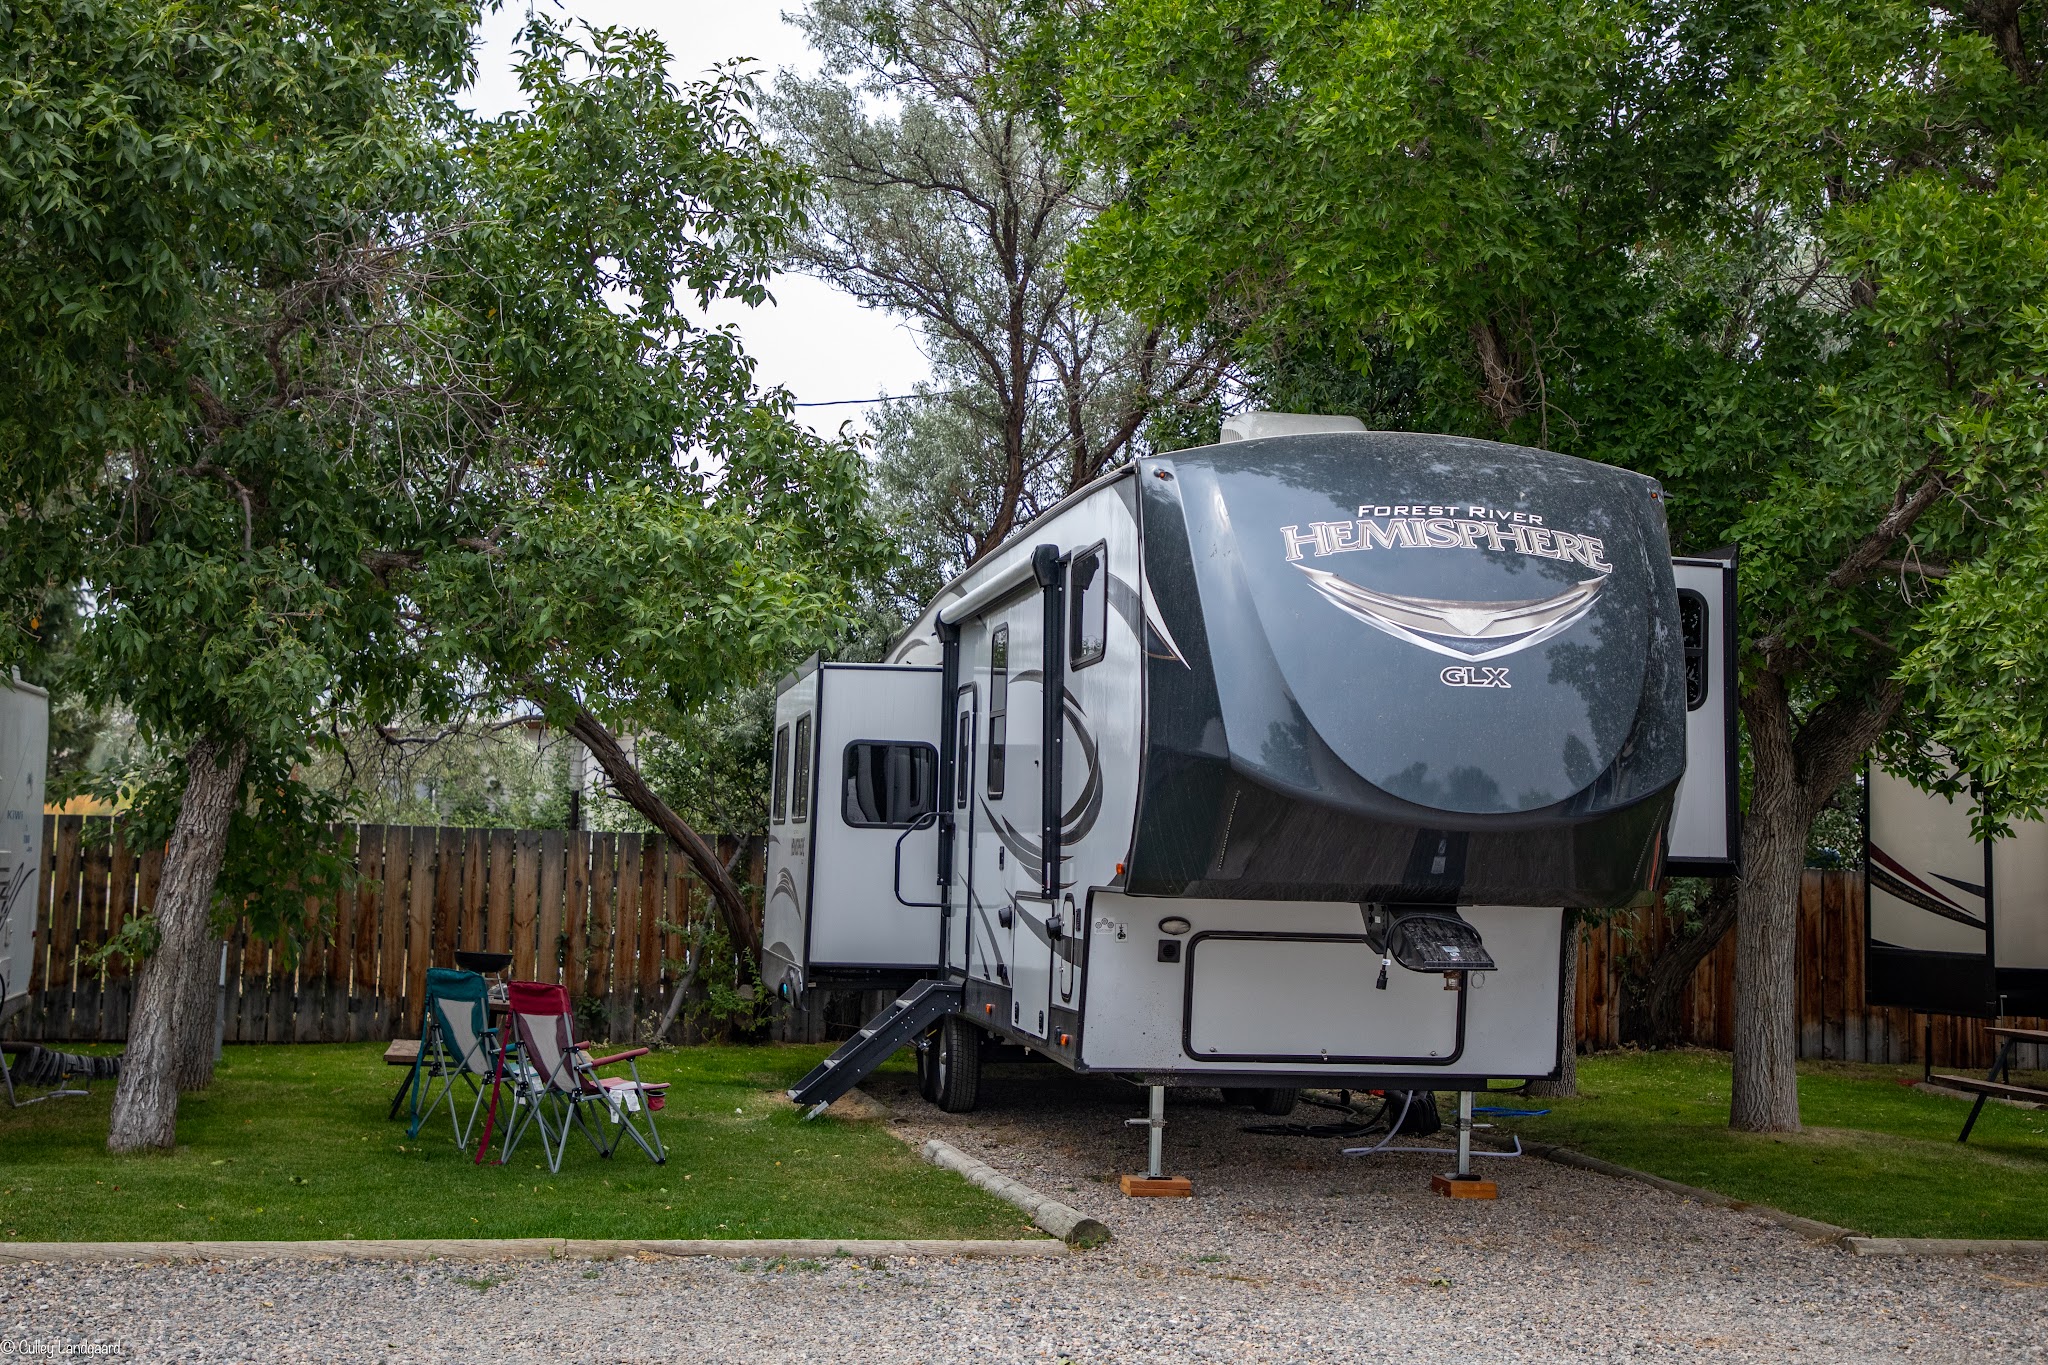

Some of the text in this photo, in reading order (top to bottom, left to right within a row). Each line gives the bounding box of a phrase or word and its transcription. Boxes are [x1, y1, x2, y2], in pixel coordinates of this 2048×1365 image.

[1357, 504, 1543, 526] FOREST RIVER
[1279, 517, 1614, 575] HEMISPHERE
[1439, 666, 1512, 689] GLX
